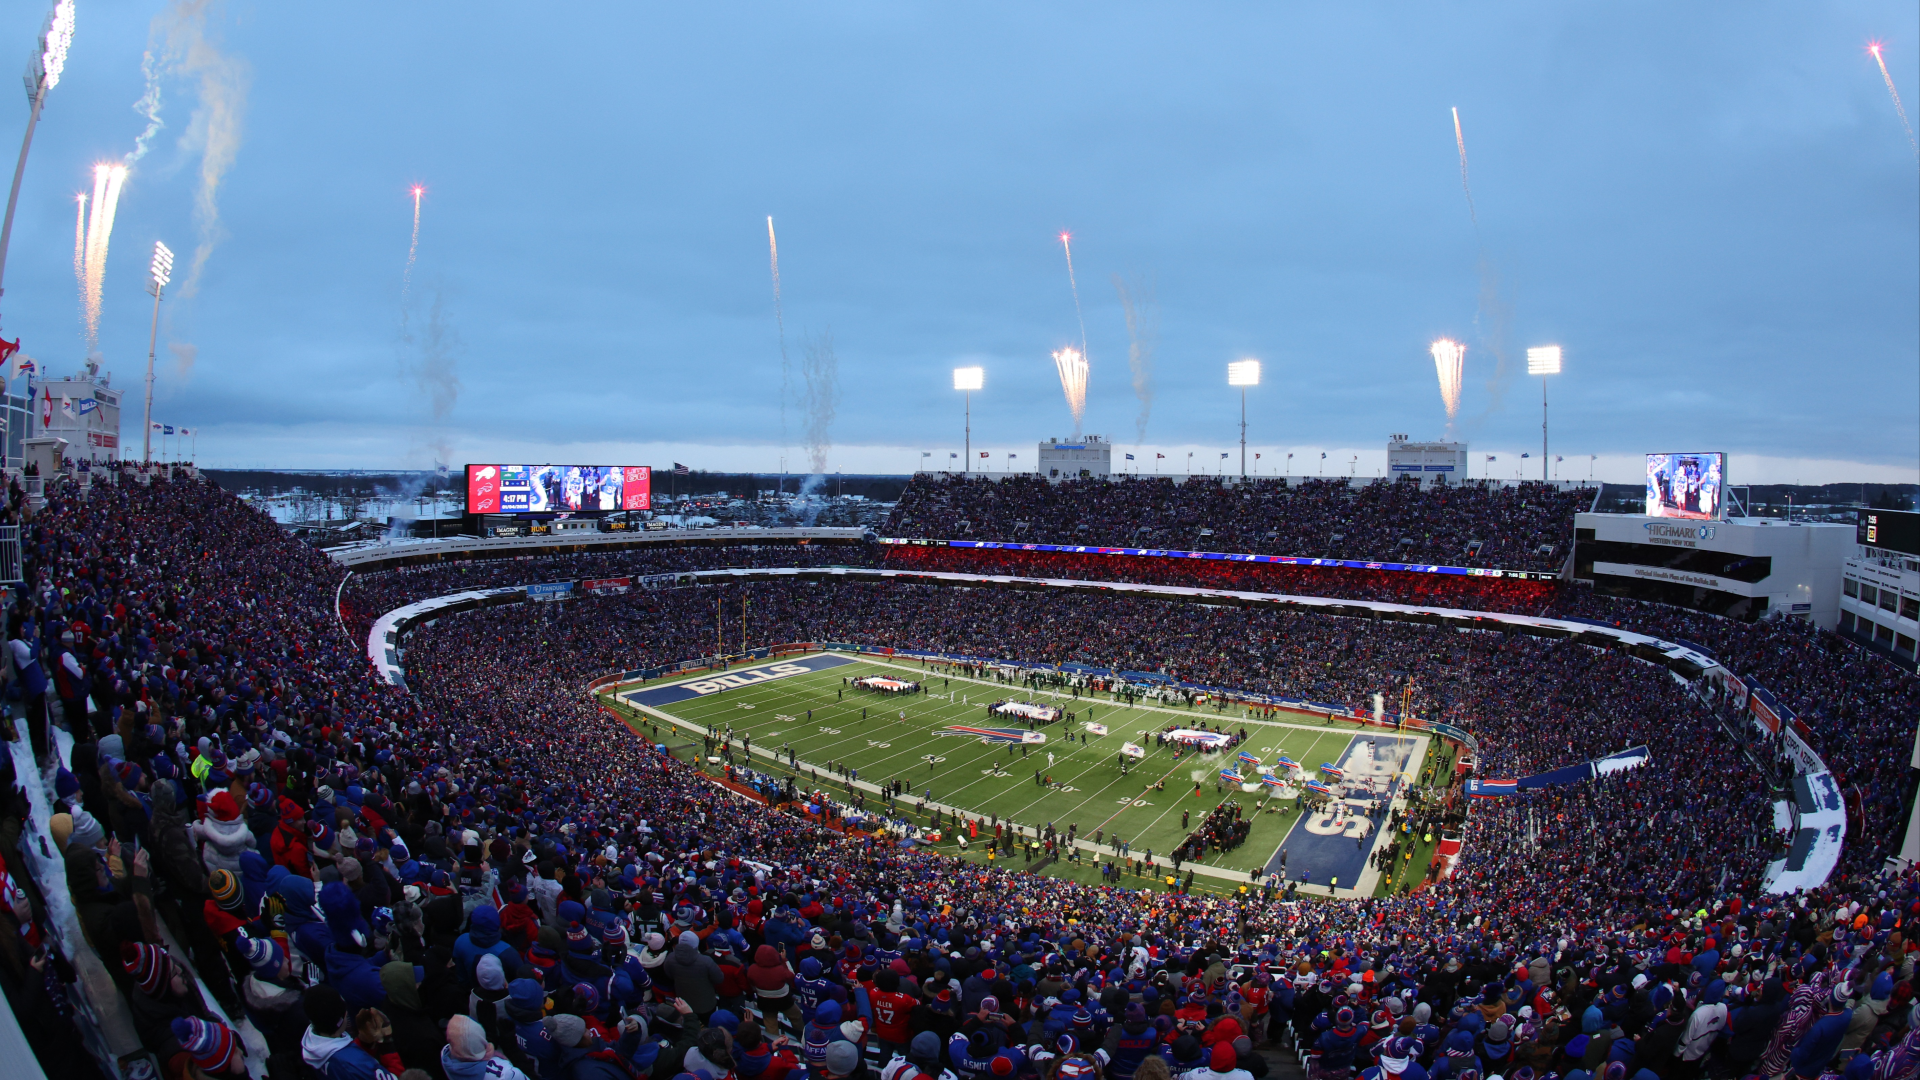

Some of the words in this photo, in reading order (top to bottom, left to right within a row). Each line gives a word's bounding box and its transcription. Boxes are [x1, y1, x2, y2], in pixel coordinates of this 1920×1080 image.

[503, 495, 516, 503] 4:17
[517, 494, 527, 503] PM
[1649, 525, 1696, 539] HIGHMARK
[1649, 537, 1671, 545] WESTERN
[643, 574, 676, 583] GEICO
[1635, 569, 1652, 577] Official
[1653, 571, 1668, 579] Health
[679, 664, 811, 694] BILLS
[1786, 735, 1800, 755] ZIPPO
[1803, 752, 1816, 772] ZIPPO
[801, 987, 816, 996] ALLEN
[802, 995, 818, 1009] 17
[876, 1000, 893, 1008] ALLEN
[875, 1007, 895, 1025] 17
[485, 1059, 503, 1078] 17
